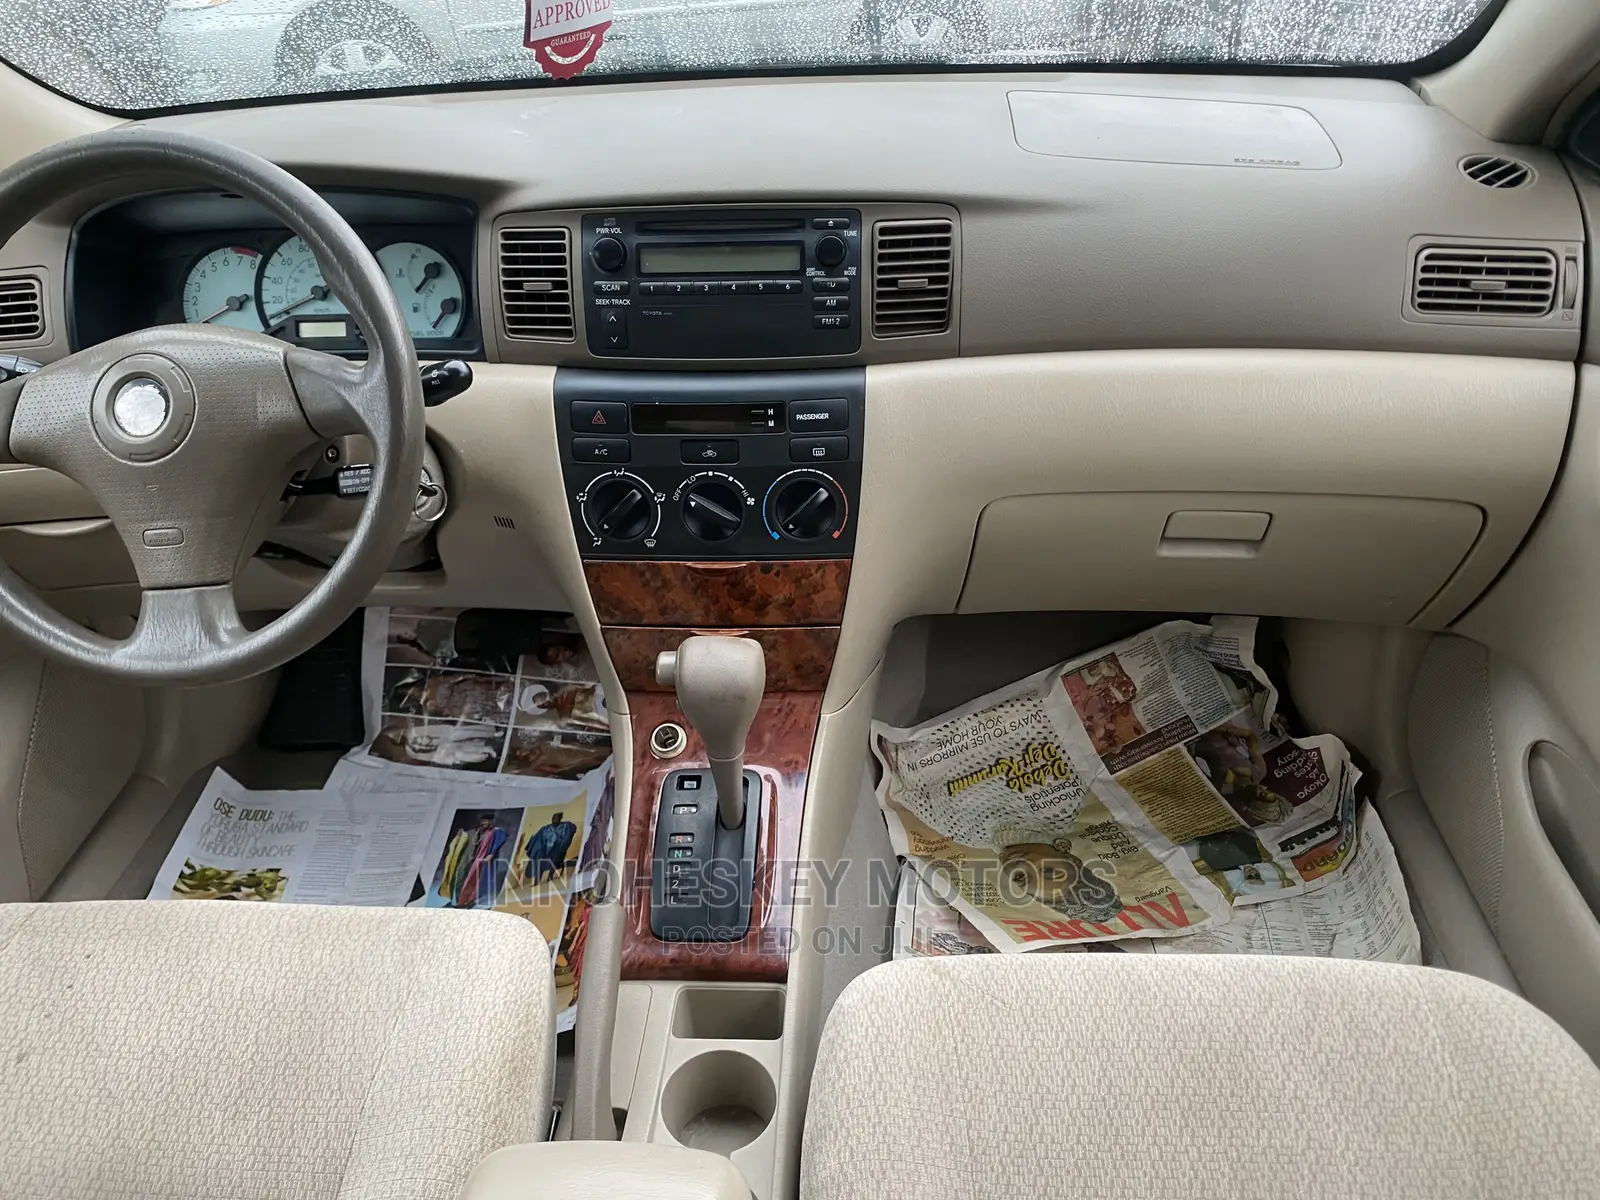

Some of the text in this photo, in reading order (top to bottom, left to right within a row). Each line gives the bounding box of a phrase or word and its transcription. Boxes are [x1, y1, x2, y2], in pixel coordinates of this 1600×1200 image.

[532, 0, 610, 29] APPROVED
[550, 31, 592, 47] GUARANTEED
[298, 244, 310, 253] 80
[222, 257, 230, 266] 6
[237, 256, 243, 267] 7
[249, 259, 257, 270] 8
[281, 257, 293, 266] 60
[211, 262, 218, 272] 5
[200, 270, 206, 279] 4
[271, 276, 283, 285] 40
[194, 282, 201, 292] 3
[601, 284, 621, 292] SCAN
[192, 296, 198, 306] 2
[271, 296, 283, 304] 20
[796, 412, 829, 421] PASSENGER
[594, 448, 608, 456] A/C
[686, 475, 696, 484] LO
[672, 487, 682, 502] OFF
[741, 489, 749, 498] HI
[936, 715, 1003, 750] YOUR HOME
[907, 711, 1042, 773] WAYS TO USE MIRRORS IN
[1007, 758, 1072, 793] Debola
[1296, 773, 1327, 799] Okoya
[1024, 779, 1081, 804] Potentials
[1030, 788, 1086, 813] Unlocking
[239, 809, 275, 821] DUDU:
[679, 806, 687, 814] P
[675, 835, 683, 843] R
[1091, 832, 1126, 843] Unique
[1111, 838, 1131, 850] And
[674, 850, 682, 858] N
[1097, 850, 1120, 861] Bold
[672, 864, 681, 873] D
[672, 879, 679, 888] 2
[1135, 885, 1173, 903] Vanguard
[670, 895, 677, 904] L
